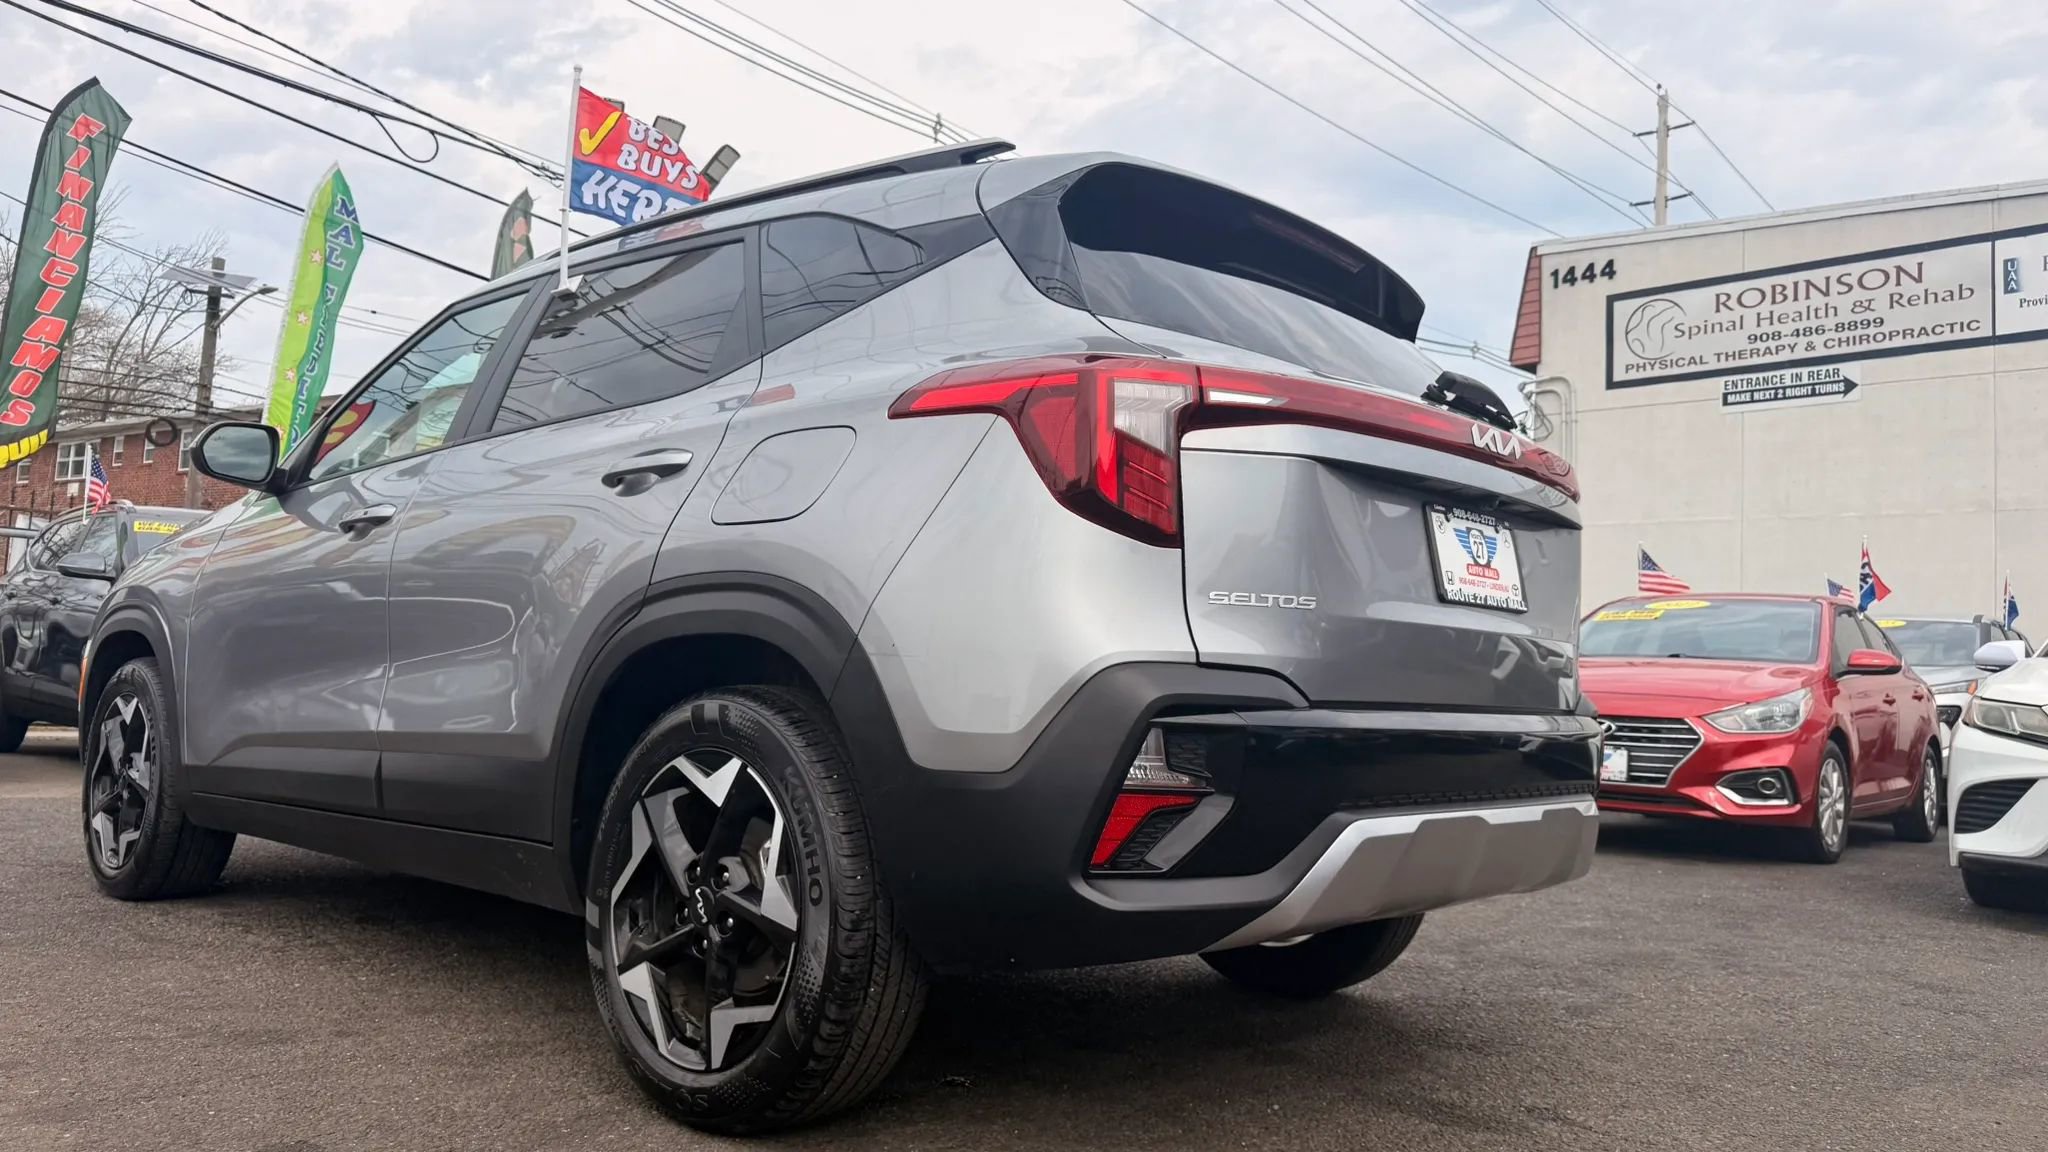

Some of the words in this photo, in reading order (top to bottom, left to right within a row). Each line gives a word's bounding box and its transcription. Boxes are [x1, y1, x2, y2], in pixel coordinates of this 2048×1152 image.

[626, 116, 679, 155] BES
[617, 144, 700, 190] BUYS
[327, 195, 360, 270] MAL
[0, 113, 106, 426] FINANCIAMOS
[1550, 259, 1616, 289] 1444
[2007, 261, 2017, 291] UAA
[1714, 262, 1924, 313] ROBINSON
[1673, 315, 1744, 339] Spinal
[1755, 303, 1838, 328] Health
[1850, 298, 1876, 315] &
[1889, 284, 1974, 310] Rehab
[1624, 355, 1709, 374] PHYSICAL
[1714, 342, 1798, 363] THERAPY
[1804, 341, 1817, 353] &
[1823, 319, 1982, 350] CHIROPRACTIC
[1747, 317, 1885, 344] 908-486-8899
[1724, 373, 1786, 391] ENTRANCE
[1790, 371, 1803, 384] IN
[1807, 368, 1840, 381] REAR
[1727, 392, 1751, 404] MAKE
[1753, 390, 1775, 401] NEXT
[1777, 390, 1784, 398] 2
[1785, 386, 1813, 397] RIGHT
[1814, 382, 1845, 394] TURNS
[1471, 423, 1521, 459] KIA
[1473, 540, 1485, 560] 27
[1208, 591, 1317, 610] SELTOS
[1447, 589, 1475, 603] ROUTE
[1487, 595, 1507, 608] AUTO
[1507, 597, 1527, 611] MALL
